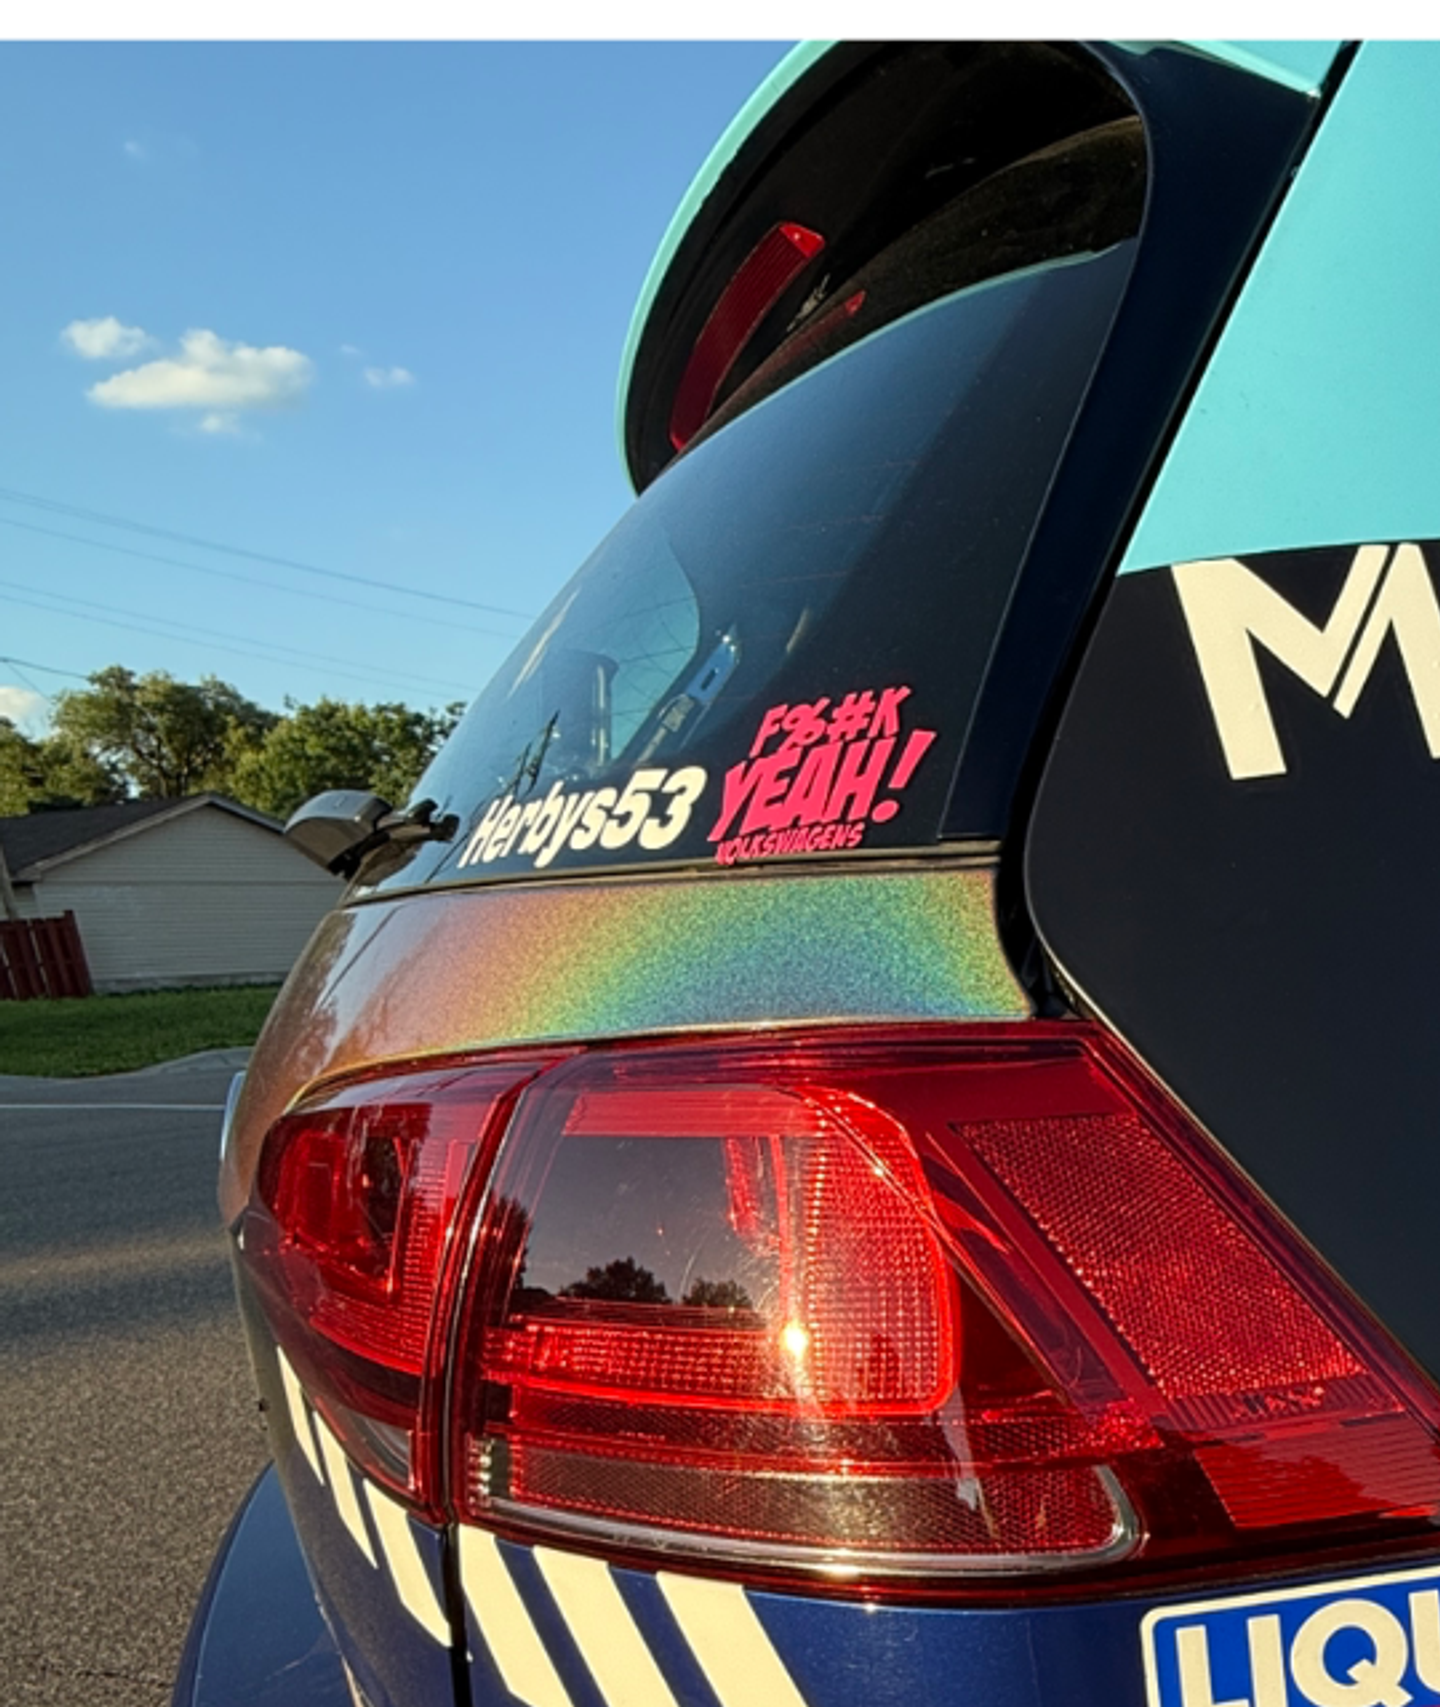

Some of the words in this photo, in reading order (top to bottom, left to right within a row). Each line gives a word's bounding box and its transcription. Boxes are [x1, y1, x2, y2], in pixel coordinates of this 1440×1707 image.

[458, 766, 709, 869] Herbys53
[707, 729, 937, 843] YEAH!
[715, 821, 866, 866] VOLKSWAGENS
